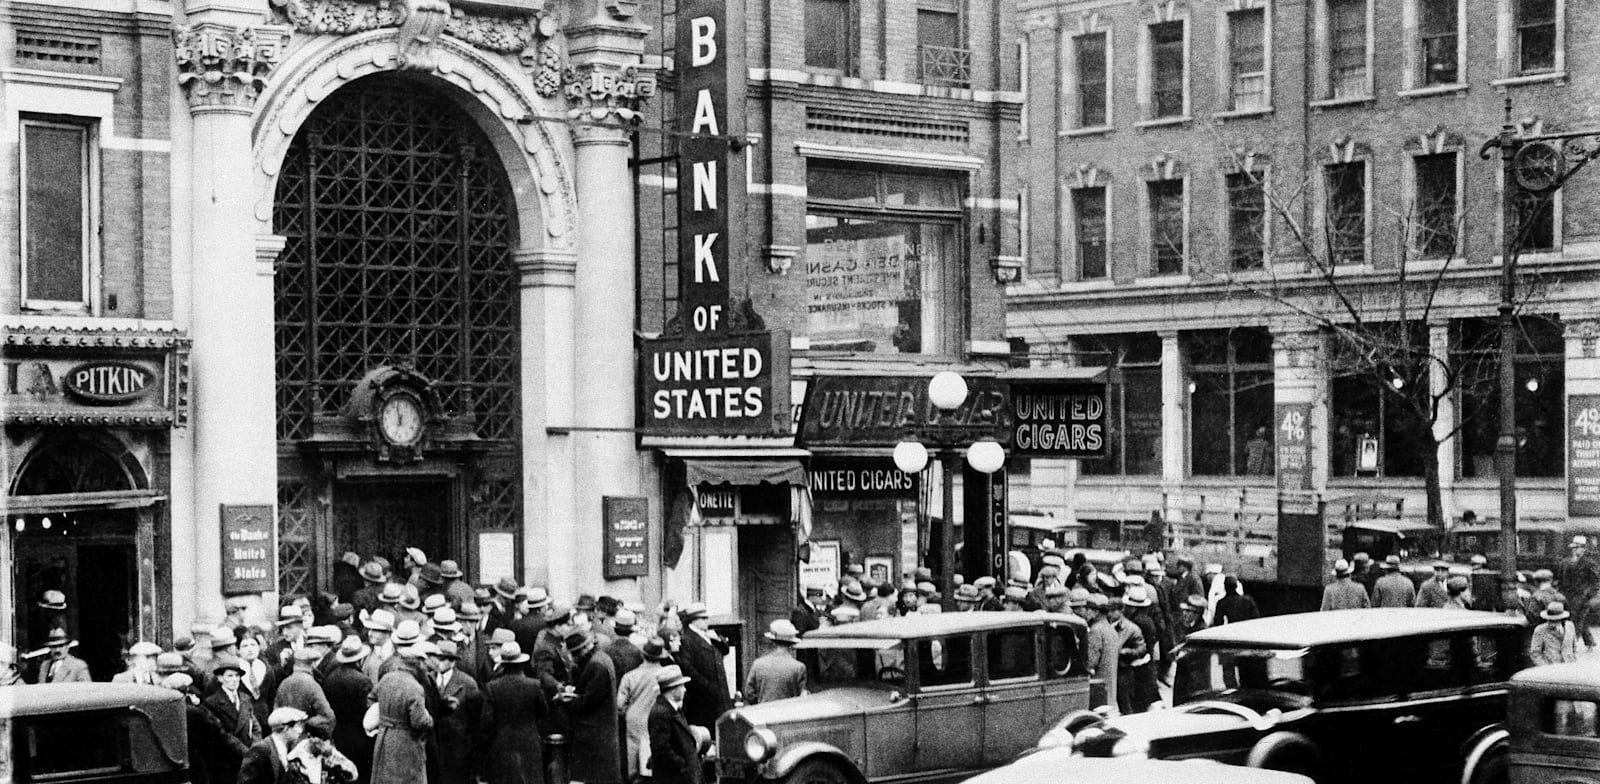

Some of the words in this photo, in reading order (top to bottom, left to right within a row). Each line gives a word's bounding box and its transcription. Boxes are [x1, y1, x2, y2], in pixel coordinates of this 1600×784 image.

[690, 16, 720, 283] BANK
[693, 305, 722, 332] OF
[653, 347, 763, 382] UNITED
[76, 366, 144, 395] PITKIN
[653, 387, 763, 419] STATES
[819, 391, 914, 428] UNITED
[1016, 394, 1103, 421] UNITED
[1016, 424, 1103, 450] CIGARS
[1281, 411, 1305, 441] 4%
[861, 470, 914, 491] CIGARS
[700, 492, 734, 508] ONETTE
